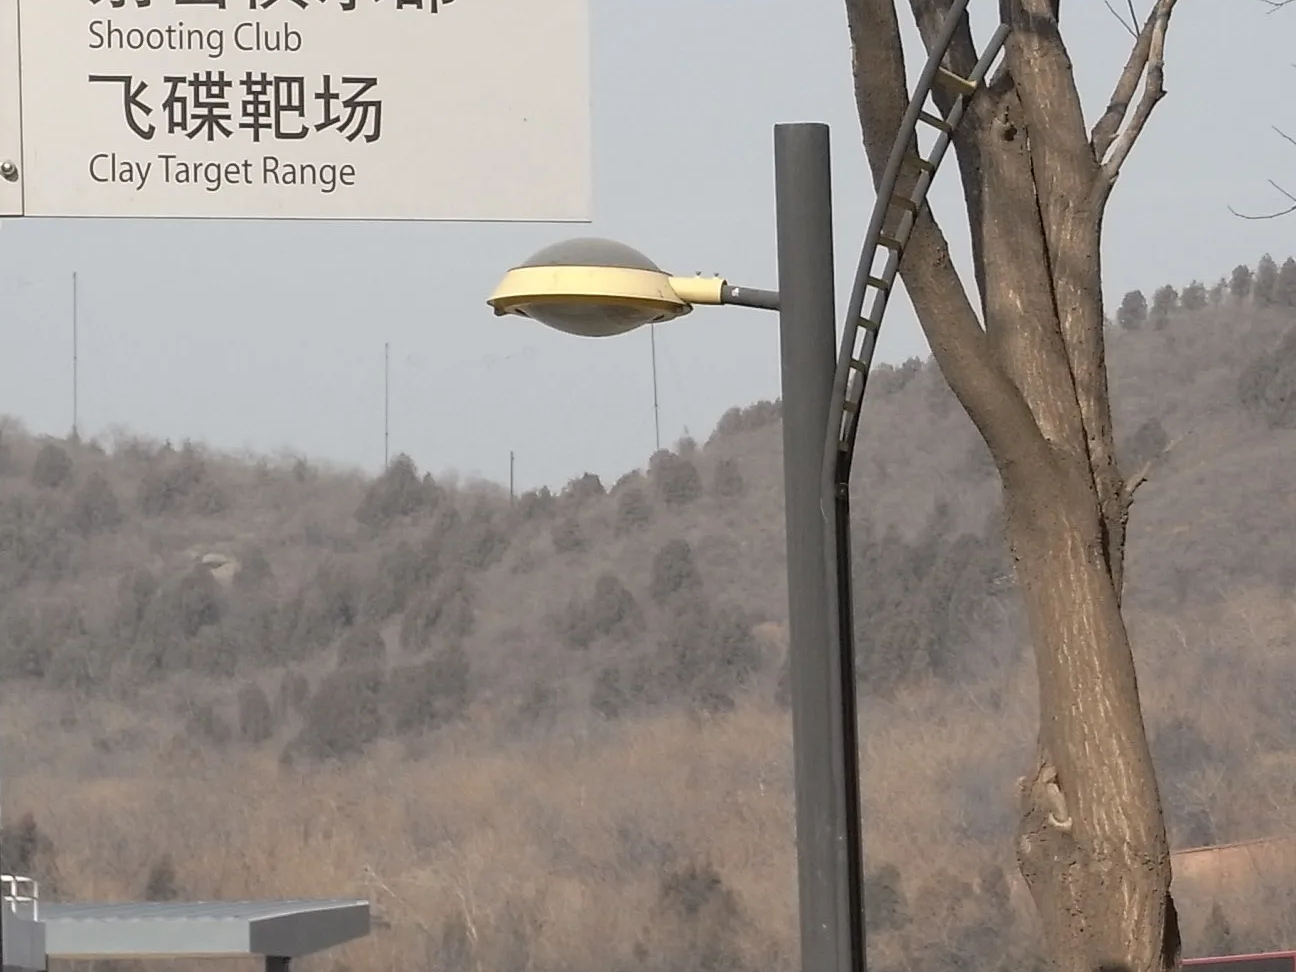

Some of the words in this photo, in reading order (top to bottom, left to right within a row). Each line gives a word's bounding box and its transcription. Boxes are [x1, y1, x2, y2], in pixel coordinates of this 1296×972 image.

[88, 19, 225, 58] Shooting
[233, 21, 303, 53] Club
[88, 70, 384, 144] 飞碟靶场
[87, 152, 152, 191] Clay
[158, 153, 253, 192] Target
[262, 155, 356, 193] Range
